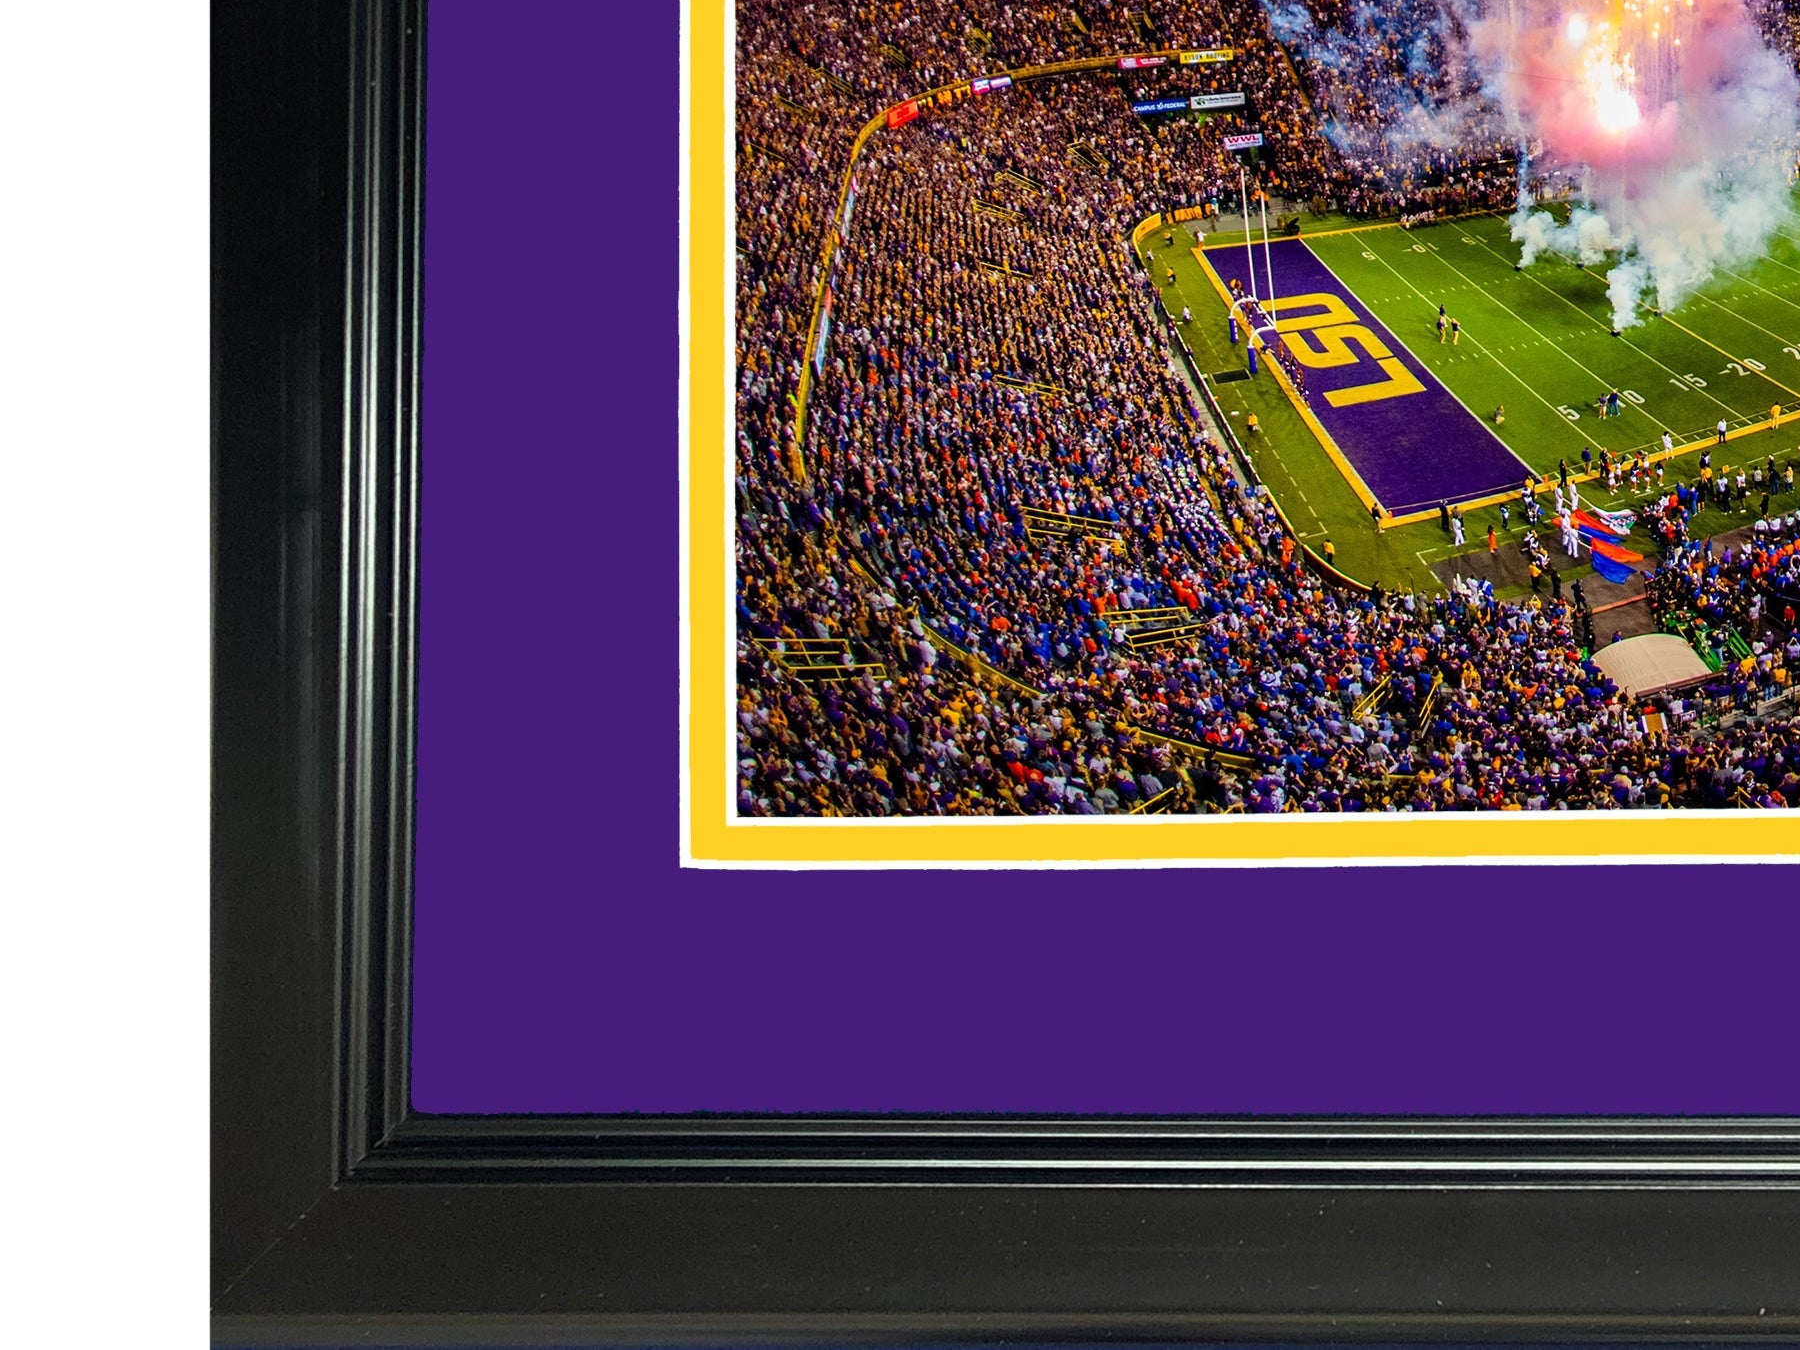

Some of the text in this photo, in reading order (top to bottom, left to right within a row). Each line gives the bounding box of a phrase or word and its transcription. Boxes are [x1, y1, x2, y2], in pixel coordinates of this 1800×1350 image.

[1134, 104, 1155, 112] CAMPUS
[1227, 135, 1259, 143] WWL
[1361, 251, 1377, 261] 5
[1259, 292, 1427, 408] LSU
[1726, 358, 1767, 377] 20
[1669, 373, 1708, 391] 15
[1557, 404, 1581, 421] 5
